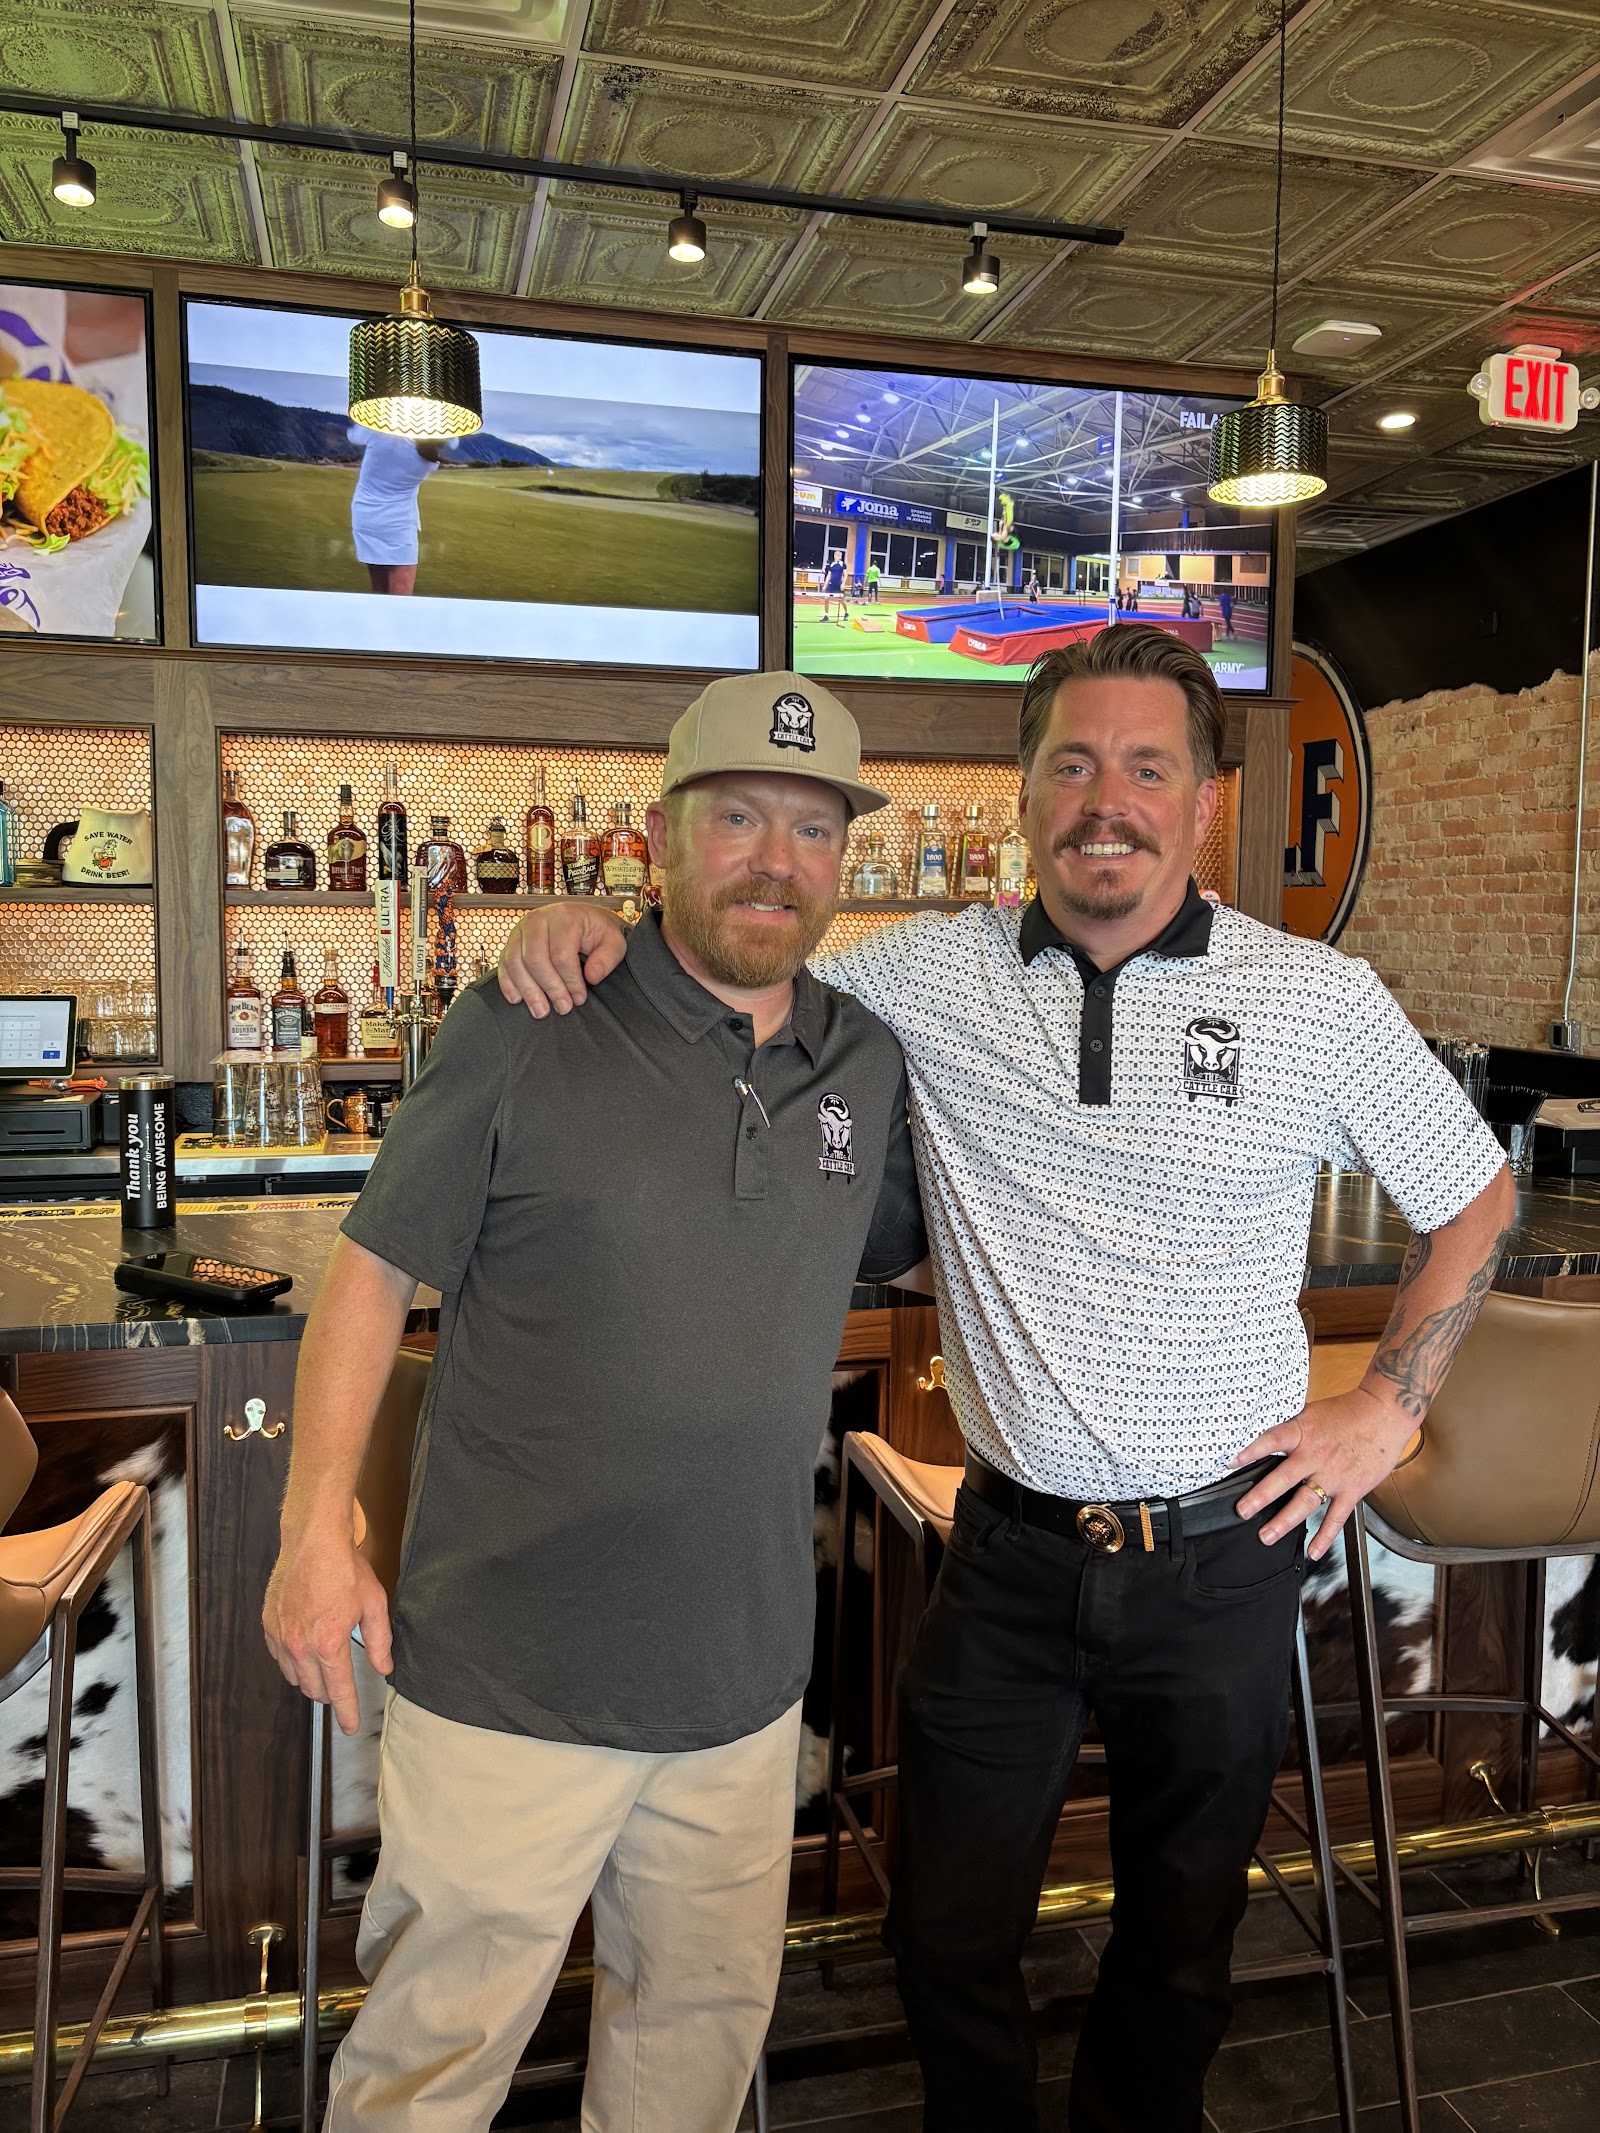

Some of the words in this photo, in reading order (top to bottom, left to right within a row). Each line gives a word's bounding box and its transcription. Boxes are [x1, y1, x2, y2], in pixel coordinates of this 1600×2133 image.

[1505, 358, 1569, 424] EXIT
[84, 831, 105, 842] SAVE
[107, 831, 133, 845] WATER
[80, 866, 103, 878] DRINK
[106, 868, 130, 879] BEER!
[926, 853, 943, 861] 1800
[380, 886, 390, 927] ULTRA
[382, 937, 393, 978] Michelob
[415, 944, 424, 974] LEGION
[229, 1004, 241, 1014] JIM
[241, 1001, 259, 1014] BEAM
[1183, 1081, 1218, 1093] CATTLE
[1220, 1084, 1238, 1096] CAR
[127, 1113, 144, 1148] you
[154, 1102, 166, 1168] AWESOME
[143, 1151, 152, 1162] for
[125, 1148, 141, 1201] Thank
[156, 1170, 168, 1209] BEING
